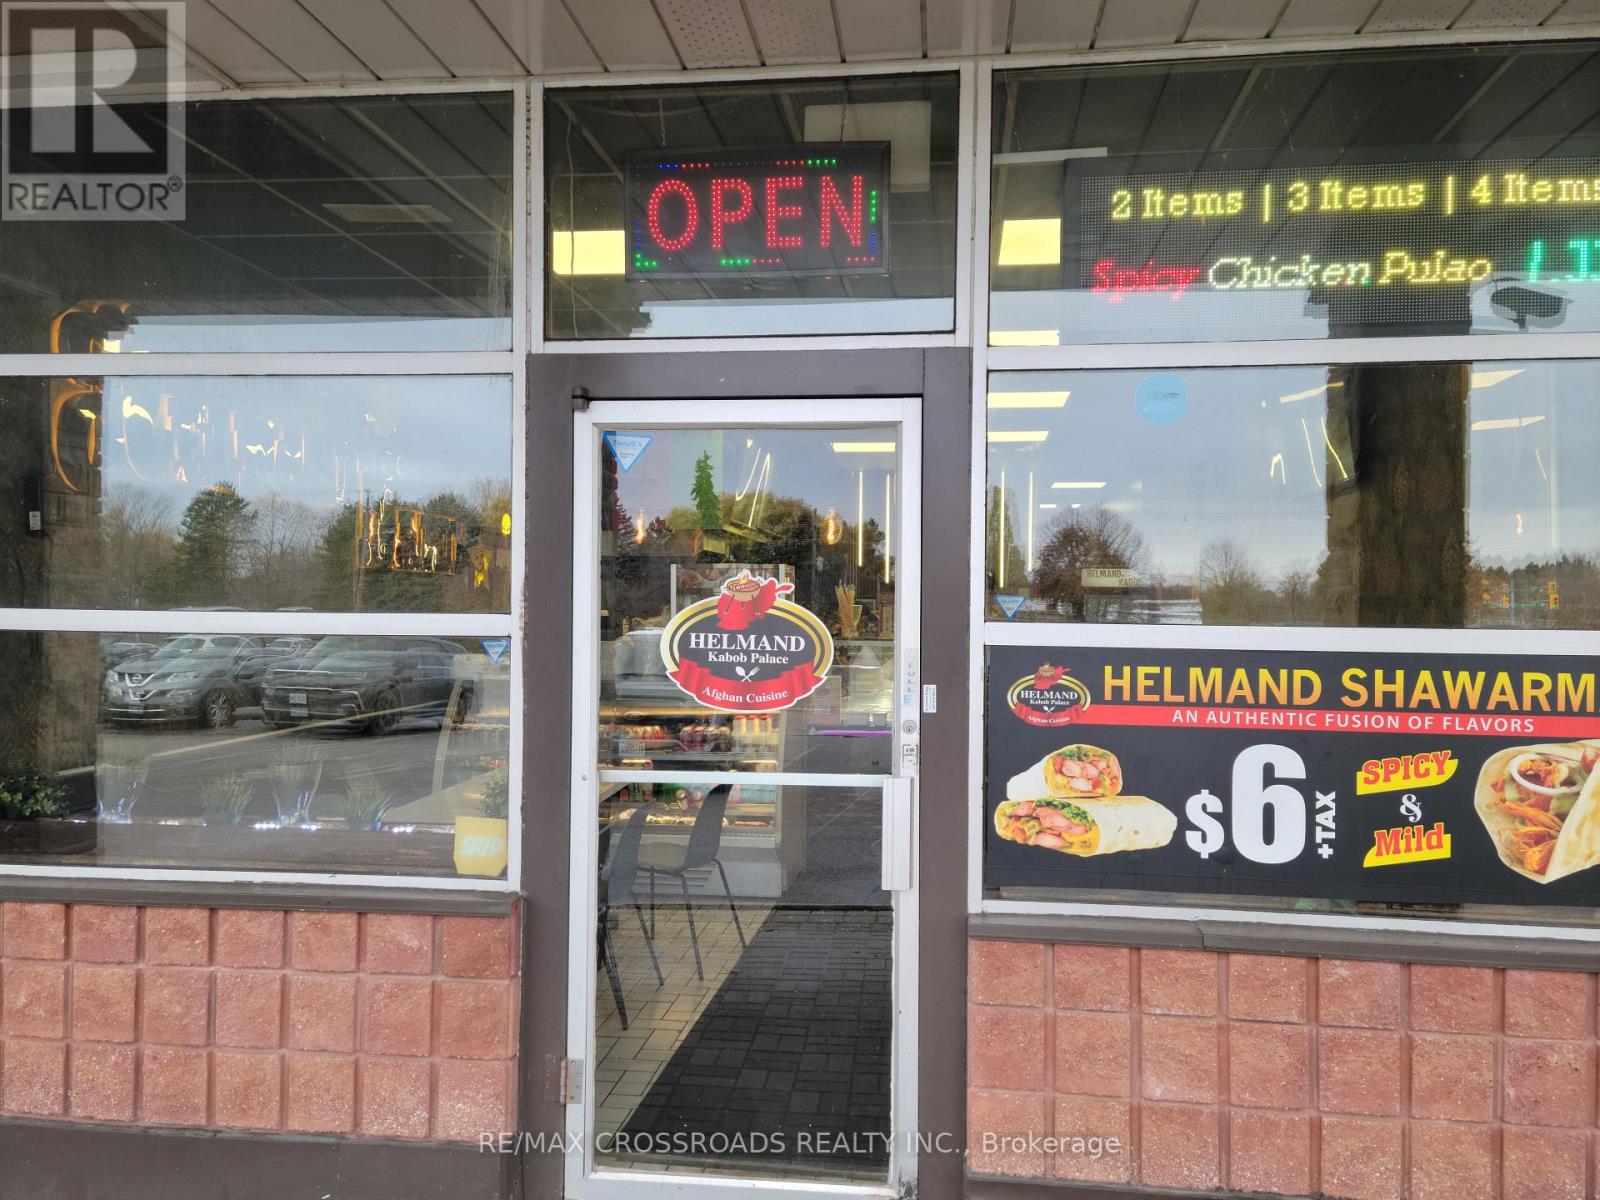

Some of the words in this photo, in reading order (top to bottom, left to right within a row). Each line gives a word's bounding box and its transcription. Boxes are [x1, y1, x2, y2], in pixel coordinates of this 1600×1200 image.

[1112, 189, 1131, 220] 2
[1142, 186, 1245, 218] Items
[1288, 181, 1310, 212] 3
[1319, 179, 1427, 212] Items
[1470, 173, 1493, 205] 4
[648, 176, 863, 251] OPEN
[1092, 258, 1200, 304] Spicy
[1208, 254, 1373, 289] Chicken
[1378, 249, 1493, 286] Pulao
[688, 632, 805, 652] HELMAND
[707, 651, 748, 664] Kabob
[751, 653, 789, 664] Palace
[701, 686, 743, 703] Afghan
[745, 689, 789, 704] Cuisine
[1020, 690, 1078, 700] HELMAND
[1104, 665, 1322, 706] HELMAND
[1341, 667, 1600, 713] SHAWARM
[1172, 709, 1198, 724] AN
[1205, 710, 1318, 728] AUTHENTIC
[1325, 713, 1400, 730] FUSION
[1407, 715, 1434, 731] OF
[1442, 716, 1534, 733] FLAVORS
[1363, 750, 1452, 785] SPICY
[1400, 793, 1423, 823] &
[1375, 822, 1445, 858] Mild
